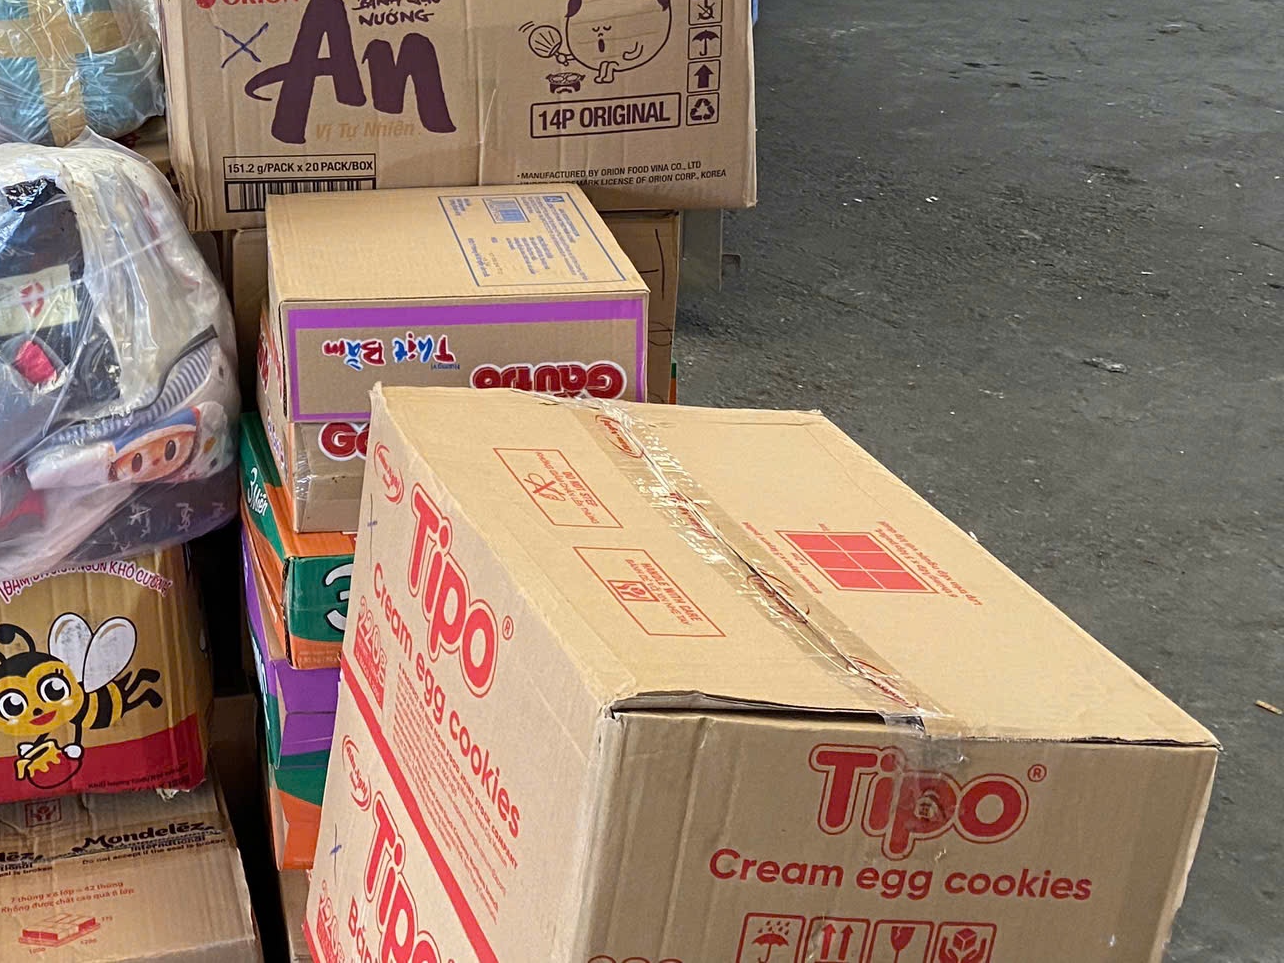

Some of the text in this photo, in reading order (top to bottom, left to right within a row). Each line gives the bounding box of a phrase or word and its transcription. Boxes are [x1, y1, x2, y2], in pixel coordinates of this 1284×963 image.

[538, 101, 671, 132] 14P ORIGINAL
[227, 163, 255, 174] 151.2
[257, 163, 295, 175] g/PACK
[305, 163, 319, 172] 20
[320, 161, 373, 172] PACK/BOX
[588, 169, 599, 178] BY
[601, 167, 625, 177] ORION
[627, 165, 649, 175] FOOD
[650, 164, 669, 173] VINA
[687, 161, 702, 170] LTD
[601, 170, 726, 185] LICENSE OF ORION KOREA
[409, 484, 498, 694] Tipo
[374, 562, 520, 838] Cream egg cookies
[809, 743, 1030, 860] Tipo
[710, 847, 1093, 901] Cream egg cookies
